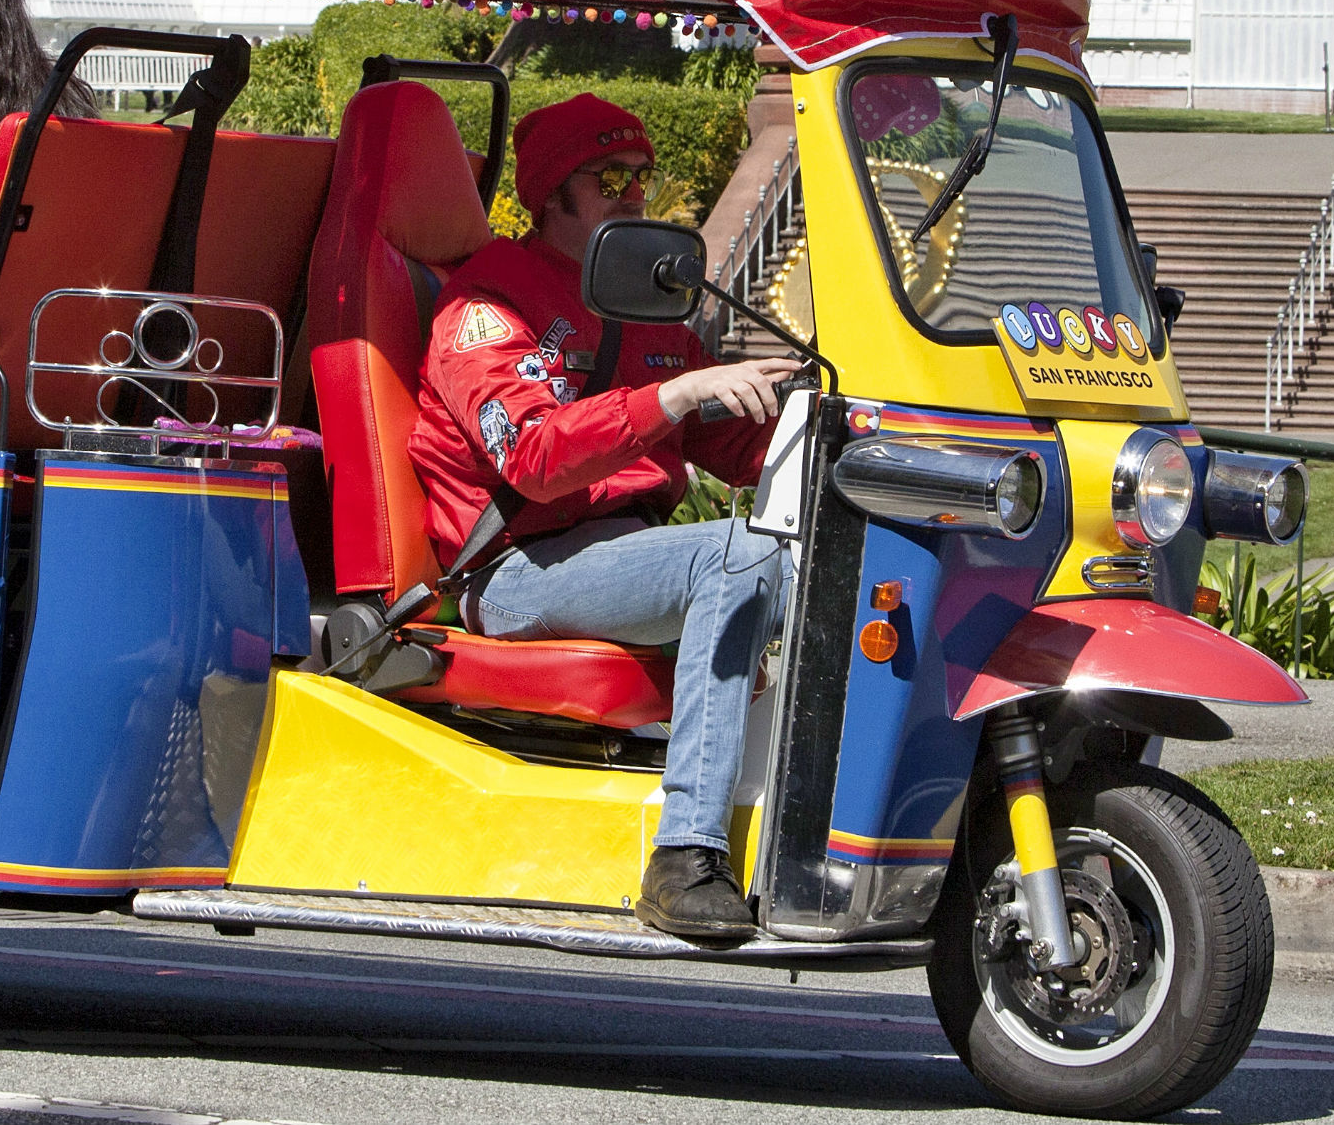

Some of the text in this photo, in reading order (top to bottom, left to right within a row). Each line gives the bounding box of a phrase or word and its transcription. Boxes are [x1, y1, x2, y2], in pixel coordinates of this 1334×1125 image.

[1008, 312, 1139, 350] LUCKY
[1028, 367, 1154, 389] SAN FRANCISCO
